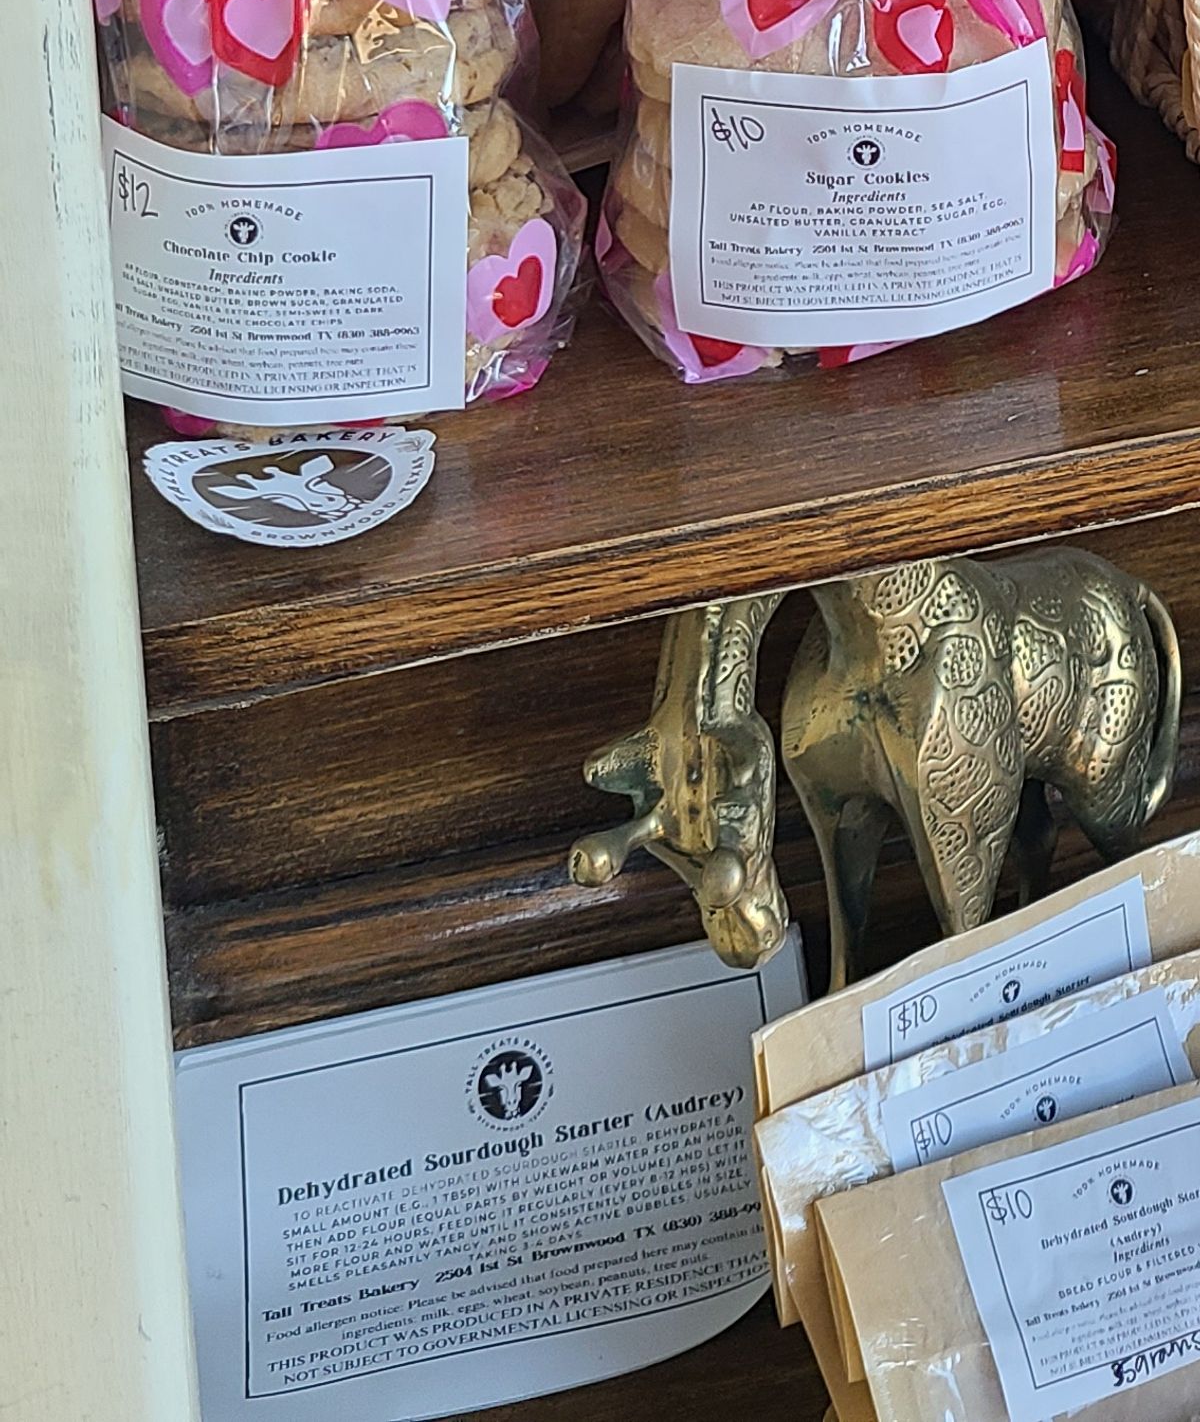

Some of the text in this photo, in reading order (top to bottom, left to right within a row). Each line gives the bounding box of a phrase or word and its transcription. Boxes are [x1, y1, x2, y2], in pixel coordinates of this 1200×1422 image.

[712, 107, 766, 152] $10
[805, 123, 922, 145] 100% HOMEMADE
[117, 164, 160, 218] $12
[804, 169, 930, 190] Sugar Cookies
[830, 189, 906, 205] Ingredients
[183, 198, 304, 221] 100% HOMEMADE
[813, 227, 867, 237] VANILLA
[161, 239, 337, 266] Chocolate Chip Cookie
[208, 267, 283, 285] Ingredients
[161, 442, 251, 468] TREATS
[268, 430, 396, 447] BAKERY
[898, 994, 938, 1040] $10
[277, 1157, 412, 1206] Dehydrated
[423, 1130, 544, 1172] Sourdough
[554, 1112, 634, 1143] Starter
[643, 1086, 745, 1123] (Audrey)
[915, 1112, 953, 1157] $10
[1098, 1159, 1161, 1179] HOMEMADE
[285, 1235, 322, 1253] THEN
[326, 1228, 357, 1244] ADD
[360, 1216, 406, 1236] FLOUR
[464, 1193, 507, 1212] PARTS
[510, 1188, 528, 1202] BY
[532, 1175, 584, 1197] WEIGHT
[588, 1170, 608, 1184] OR
[674, 1148, 703, 1164] AND
[706, 1141, 730, 1157] LET
[733, 1138, 745, 1151] IT
[986, 1188, 1033, 1225] $10
[1039, 1217, 1109, 1250] Dehydrated
[1111, 1198, 1174, 1228] Sourdough
[1109, 1222, 1163, 1249] (Audrey)
[260, 1305, 292, 1322] Tall
[299, 1293, 352, 1313] Treats
[357, 1278, 420, 1301] Bakery
[434, 1263, 473, 1284] 2504
[505, 1254, 523, 1267] St
[530, 1230, 626, 1262] Brownwood
[632, 1223, 656, 1239] TX
[661, 1213, 703, 1233] (830)
[1112, 1235, 1170, 1264] Ingredients
[283, 1366, 319, 1385] NOT
[321, 1348, 393, 1376] SUBJECT
[394, 1343, 420, 1358] TO
[422, 1313, 562, 1351] GOVERNMENTAL
[565, 1294, 653, 1323] LICENSING
[654, 1289, 678, 1303] OR
